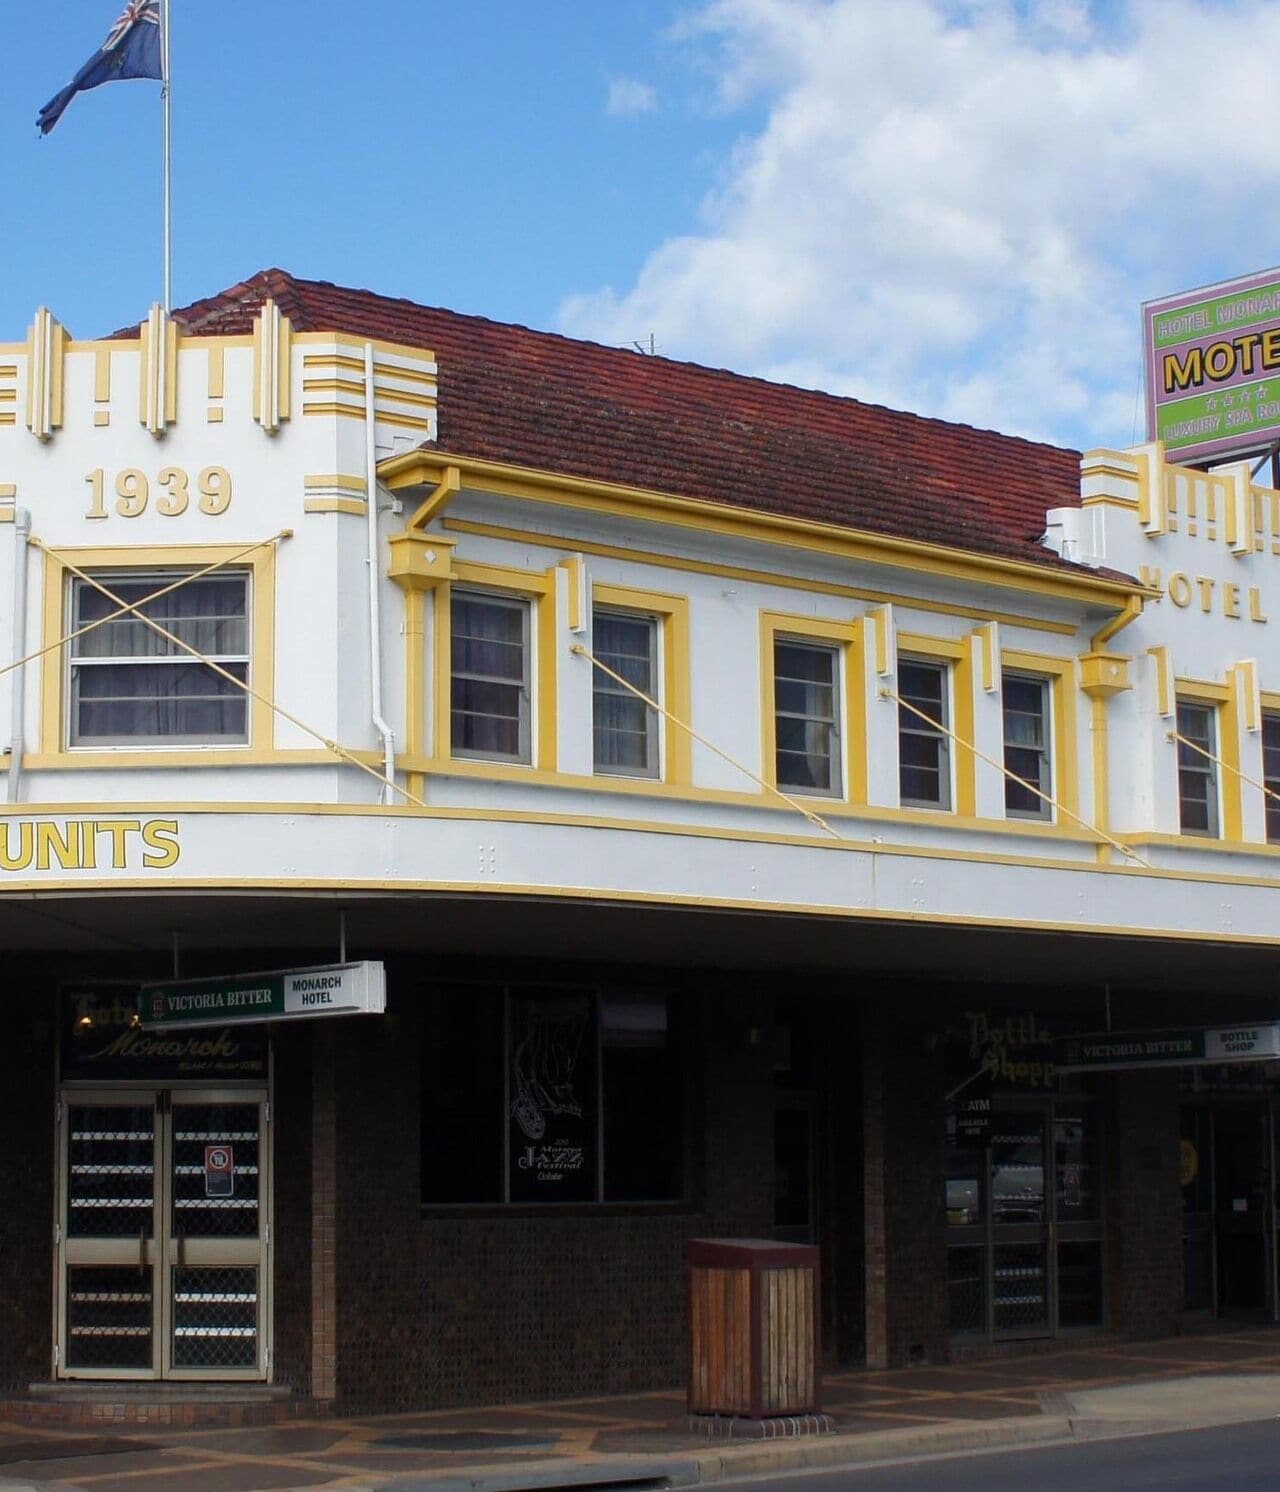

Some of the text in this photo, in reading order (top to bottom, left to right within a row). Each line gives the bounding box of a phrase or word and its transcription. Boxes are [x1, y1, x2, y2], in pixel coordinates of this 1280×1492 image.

[1157, 307, 1213, 339] HOTEL
[1163, 416, 1221, 443] LUXURY
[1225, 411, 1253, 427] SPA
[85, 466, 232, 519] 1939
[1139, 565, 1268, 623] HOTEL
[292, 976, 342, 992] MONARCH
[168, 988, 272, 1011] VICTORIA BITTER
[301, 991, 333, 1005] HOTEL
[1220, 1031, 1259, 1042] BOTTLE
[1082, 1040, 1193, 1057] VICTORIA BITTER
[1224, 1042, 1256, 1052] SHOP
